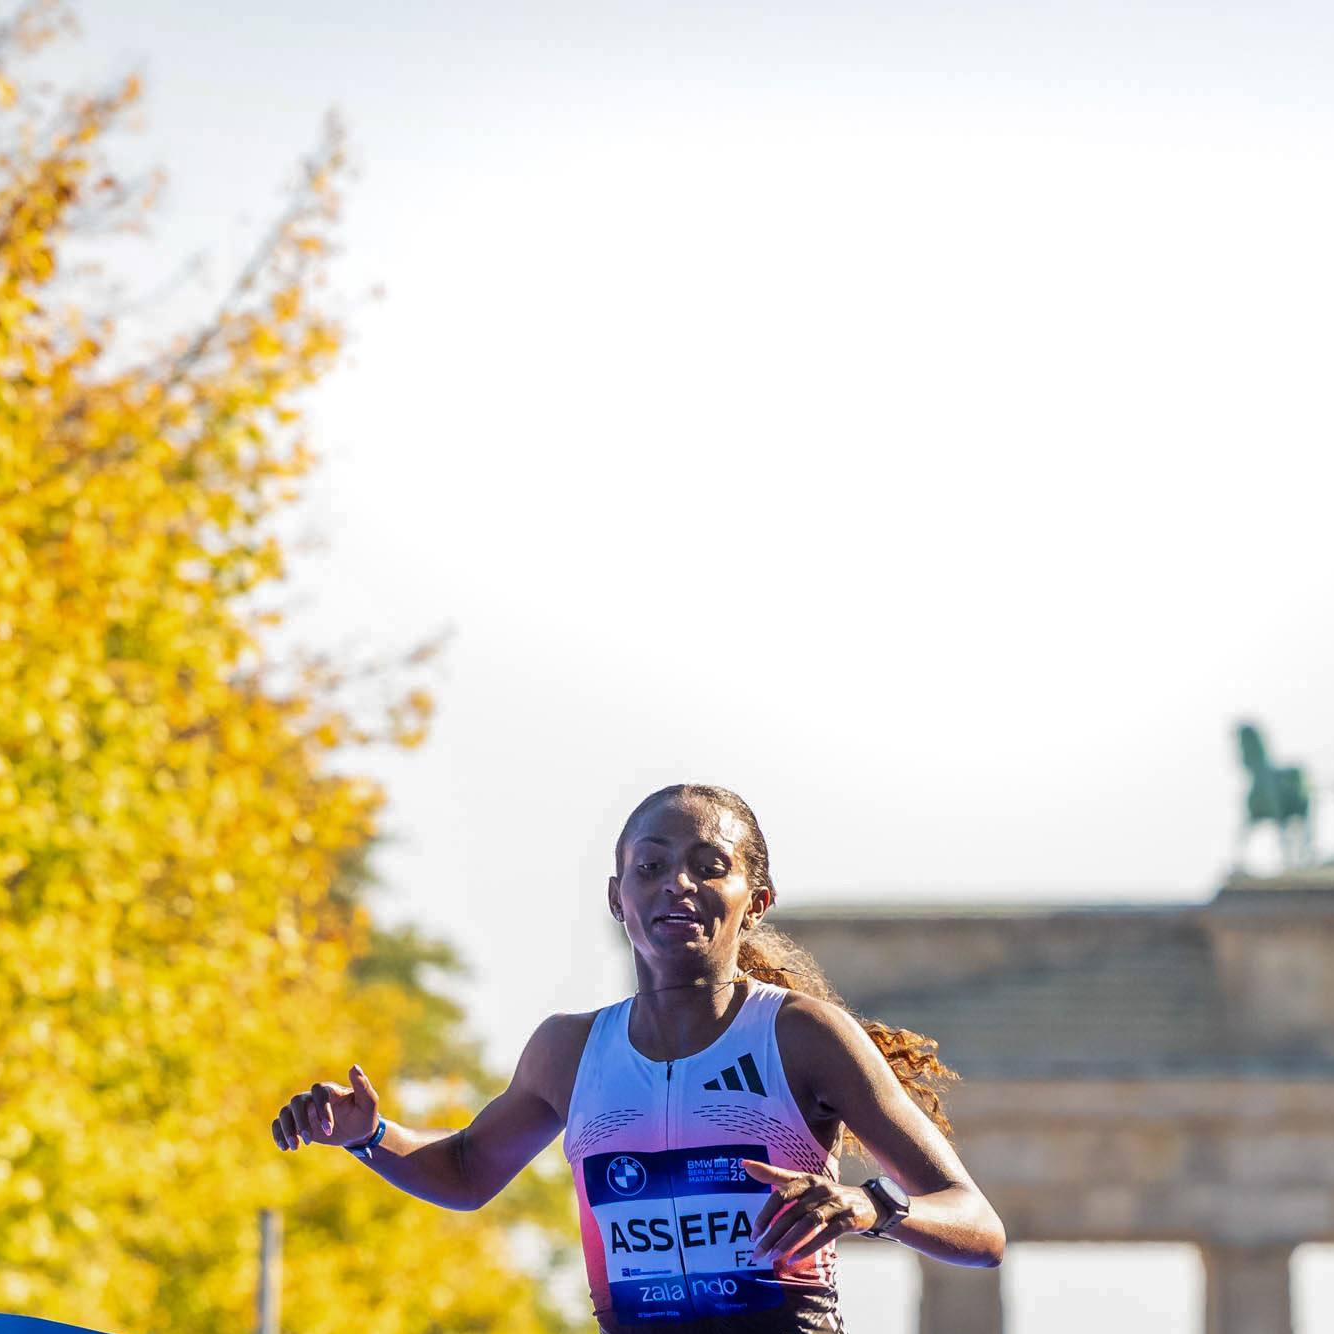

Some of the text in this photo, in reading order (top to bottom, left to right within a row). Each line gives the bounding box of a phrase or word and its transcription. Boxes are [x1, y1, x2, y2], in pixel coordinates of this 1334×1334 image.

[687, 1158, 714, 1169] BMW
[688, 1170, 747, 1183] MARATHON 26
[611, 1210, 753, 1254] ASSEFA
[639, 1277, 738, 1303] zalando
